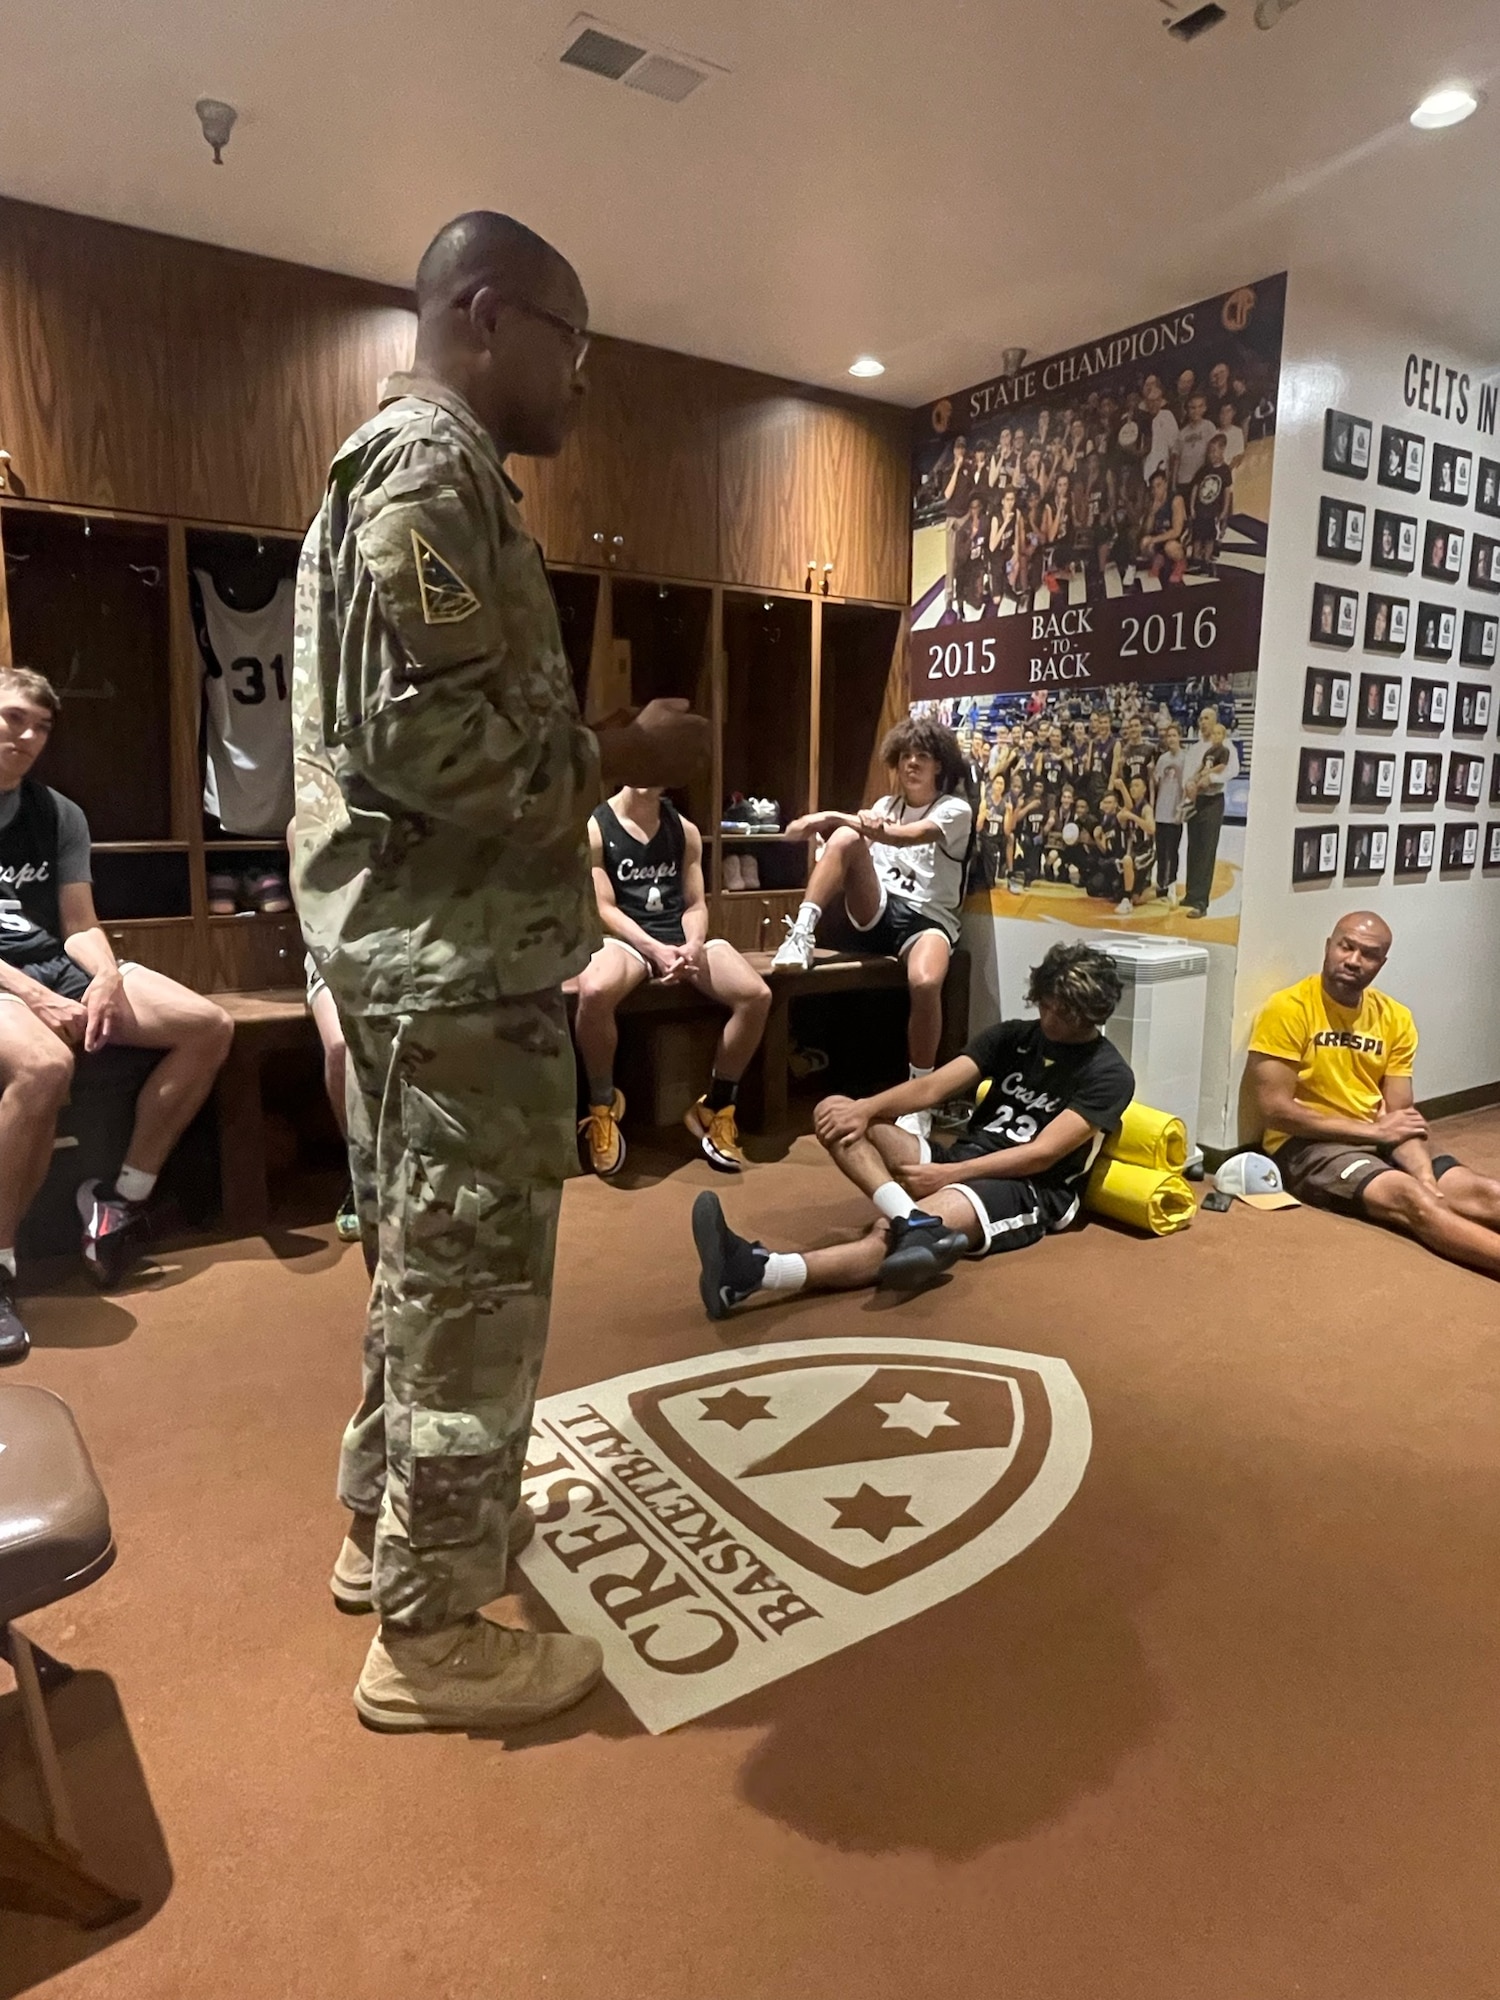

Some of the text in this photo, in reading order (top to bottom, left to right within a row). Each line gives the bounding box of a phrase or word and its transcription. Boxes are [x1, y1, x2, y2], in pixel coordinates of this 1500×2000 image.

[968, 371, 1036, 418] STATE
[1042, 312, 1196, 391] CHAMPIONS
[1403, 353, 1498, 435] CELTS IN
[927, 606, 1218, 680] 2015 TO 2016
[1030, 607, 1093, 640] BACK
[231, 653, 287, 705] 31
[1028, 652, 1092, 683] BACK
[0, 861, 50, 890] spi
[617, 858, 678, 884] Crespi
[982, 1104, 1038, 1143] 23
[558, 1403, 825, 1637] BASKETBALL
[519, 1425, 740, 1676] CRES
